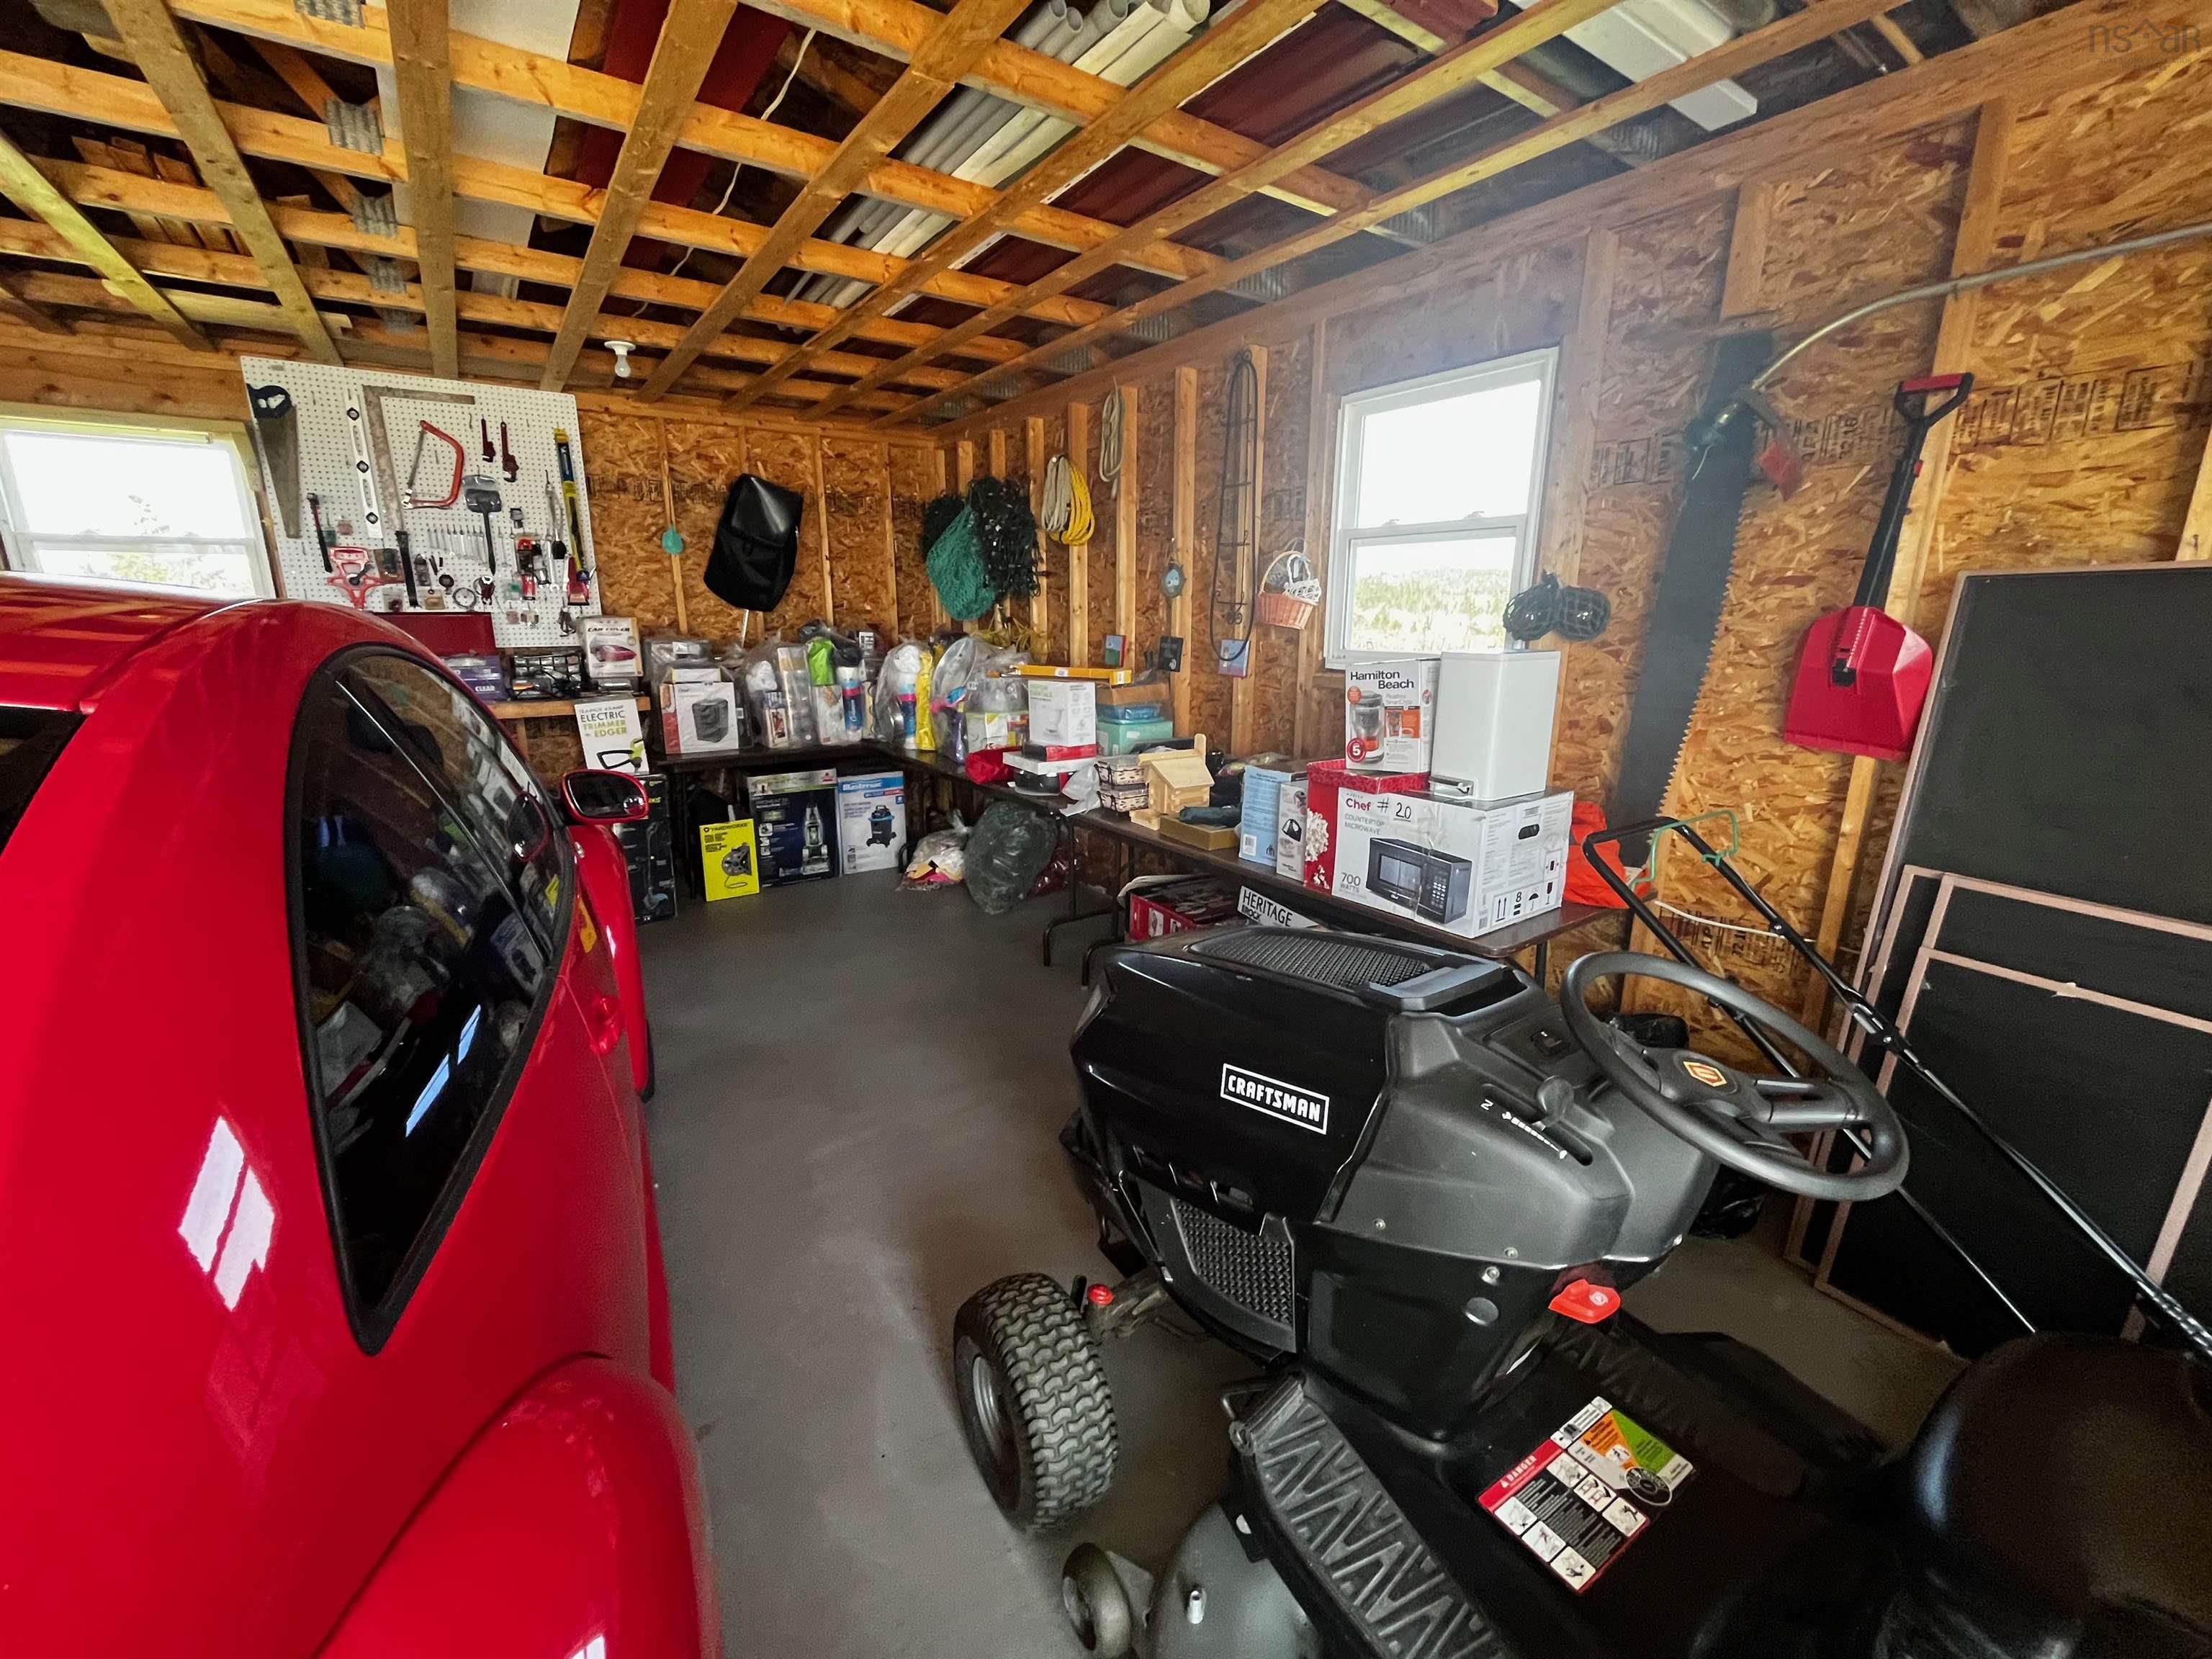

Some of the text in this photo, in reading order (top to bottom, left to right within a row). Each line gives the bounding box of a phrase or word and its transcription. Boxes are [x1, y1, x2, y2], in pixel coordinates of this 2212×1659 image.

[1350, 670, 1401, 680] Hamilton
[1378, 679, 1414, 689] Beach
[580, 710, 626, 722] ELECTRIC
[583, 720, 626, 730] TRIMMER
[594, 727, 627, 738] EDGER
[1352, 744, 1361, 756] 5
[1346, 798, 1371, 811] Chef
[1395, 802, 1412, 819] 20
[1344, 813, 1385, 827] COUNTERTOP
[1344, 822, 1381, 835] MICROWAVE
[1341, 872, 1361, 886] 700
[1339, 883, 1360, 894] WATTS
[1516, 891, 1522, 902] 8
[1243, 889, 1293, 927] HERITAGE
[1228, 1074, 1321, 1123] CRAFTSMAN
[1506, 1455, 1537, 1483] DANGER
